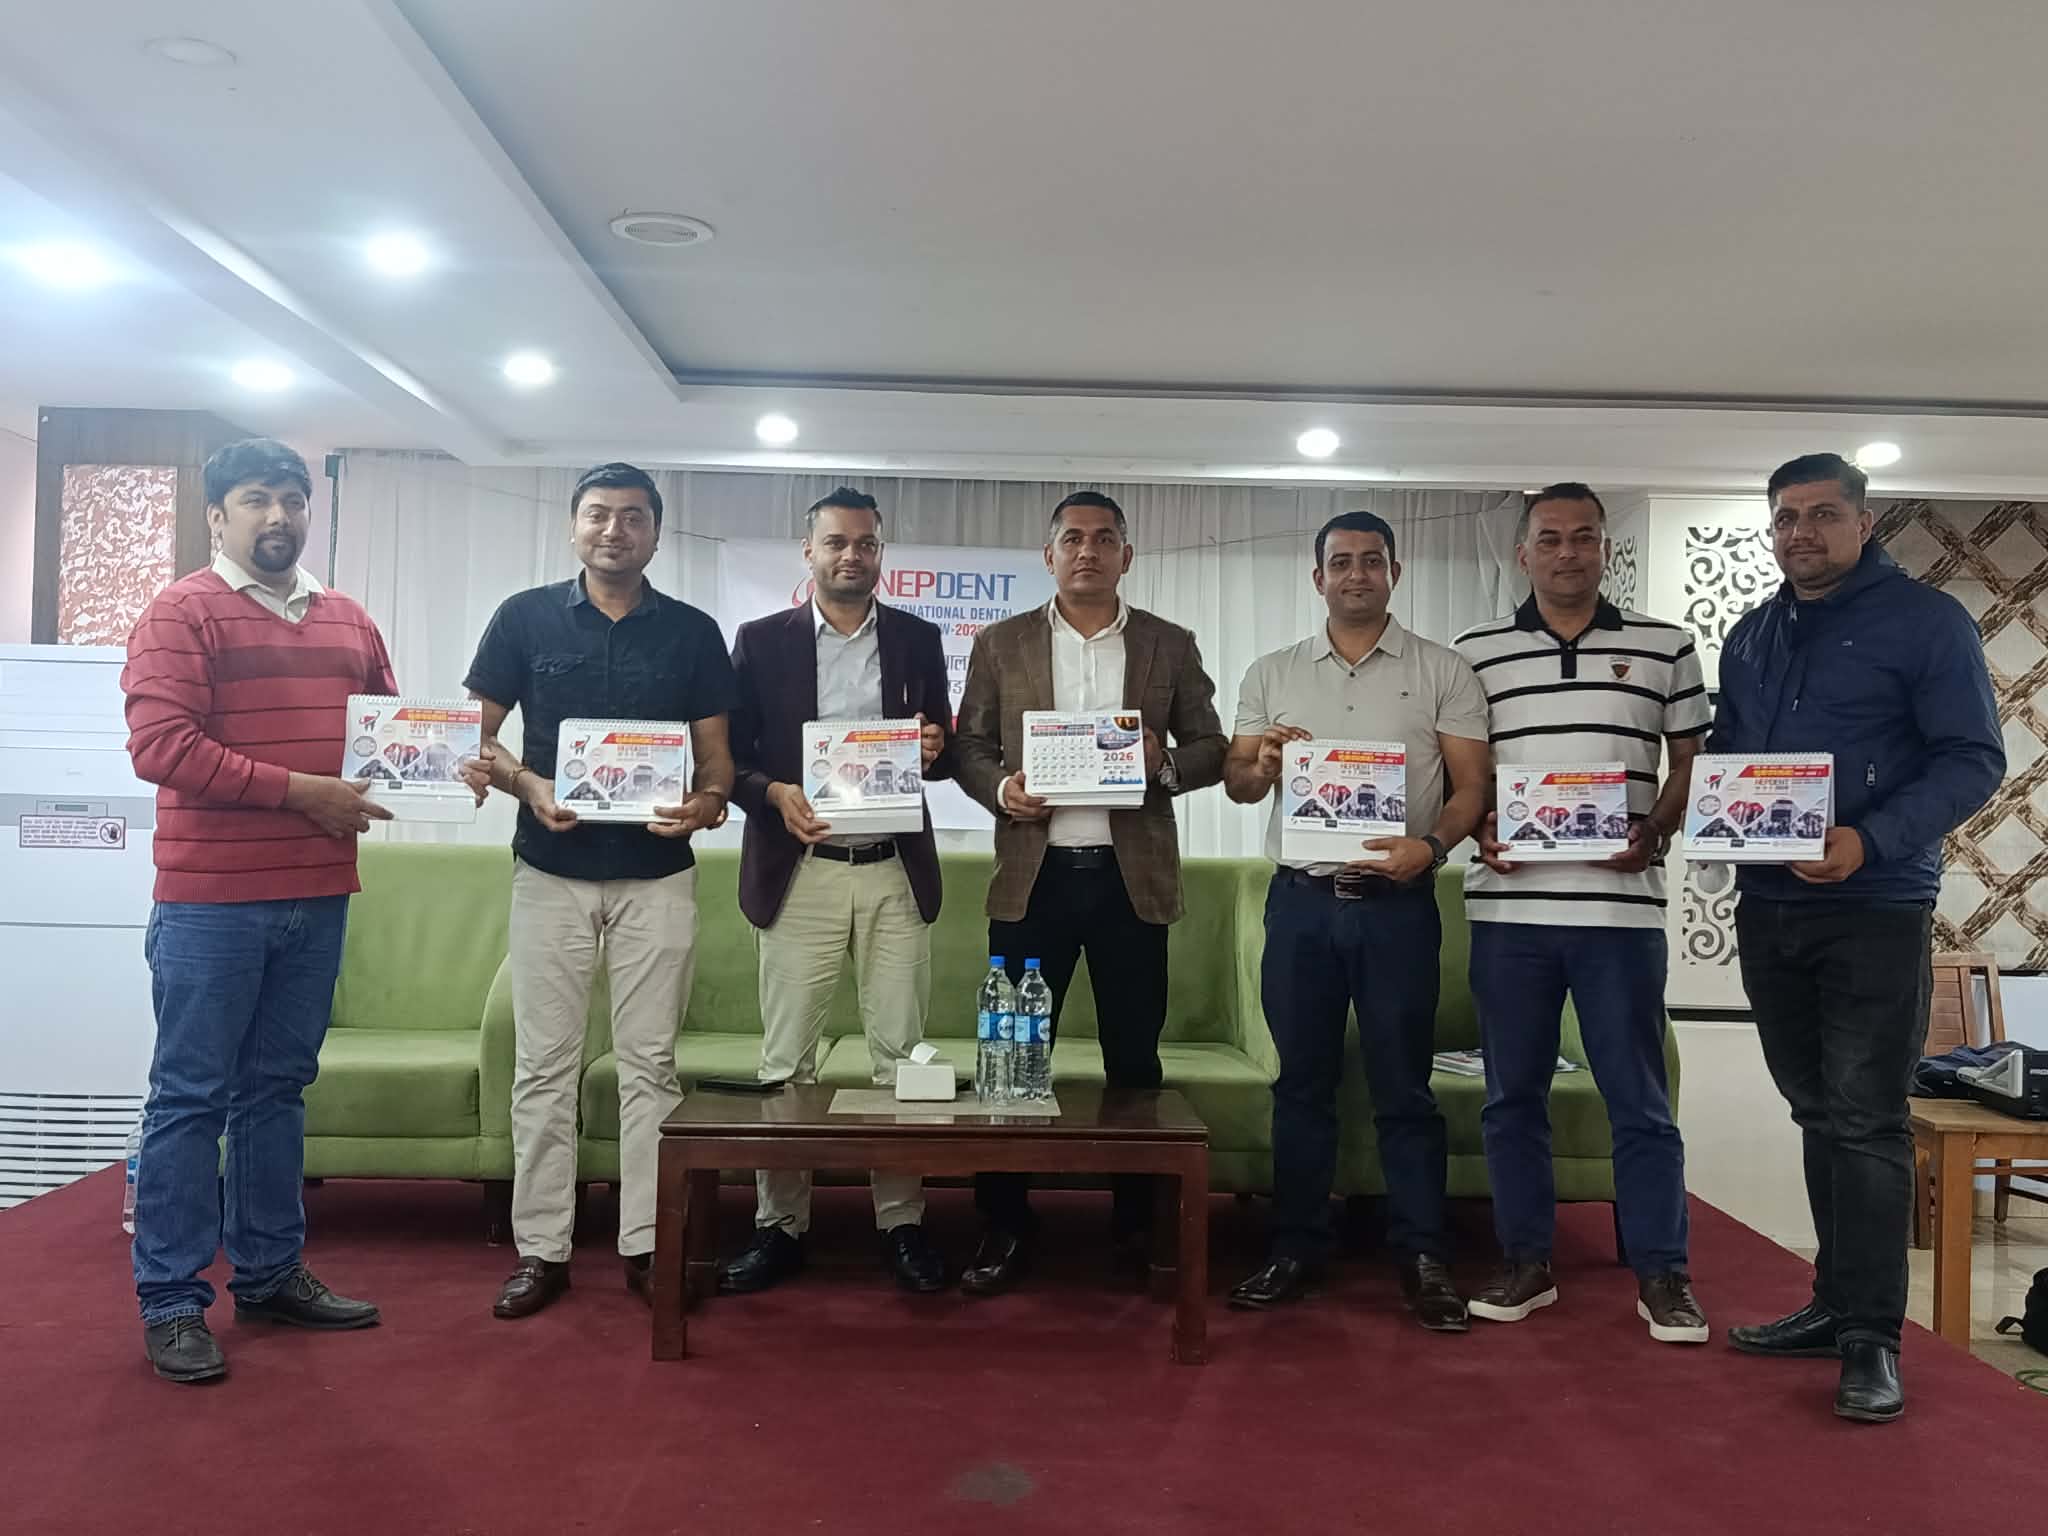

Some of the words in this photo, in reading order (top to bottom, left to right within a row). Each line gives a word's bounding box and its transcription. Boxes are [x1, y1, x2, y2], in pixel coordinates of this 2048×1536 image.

[876, 569, 1017, 601] NEPDENT
[889, 603, 965, 619] RNATIONAL
[1103, 751, 1135, 762] 2026
